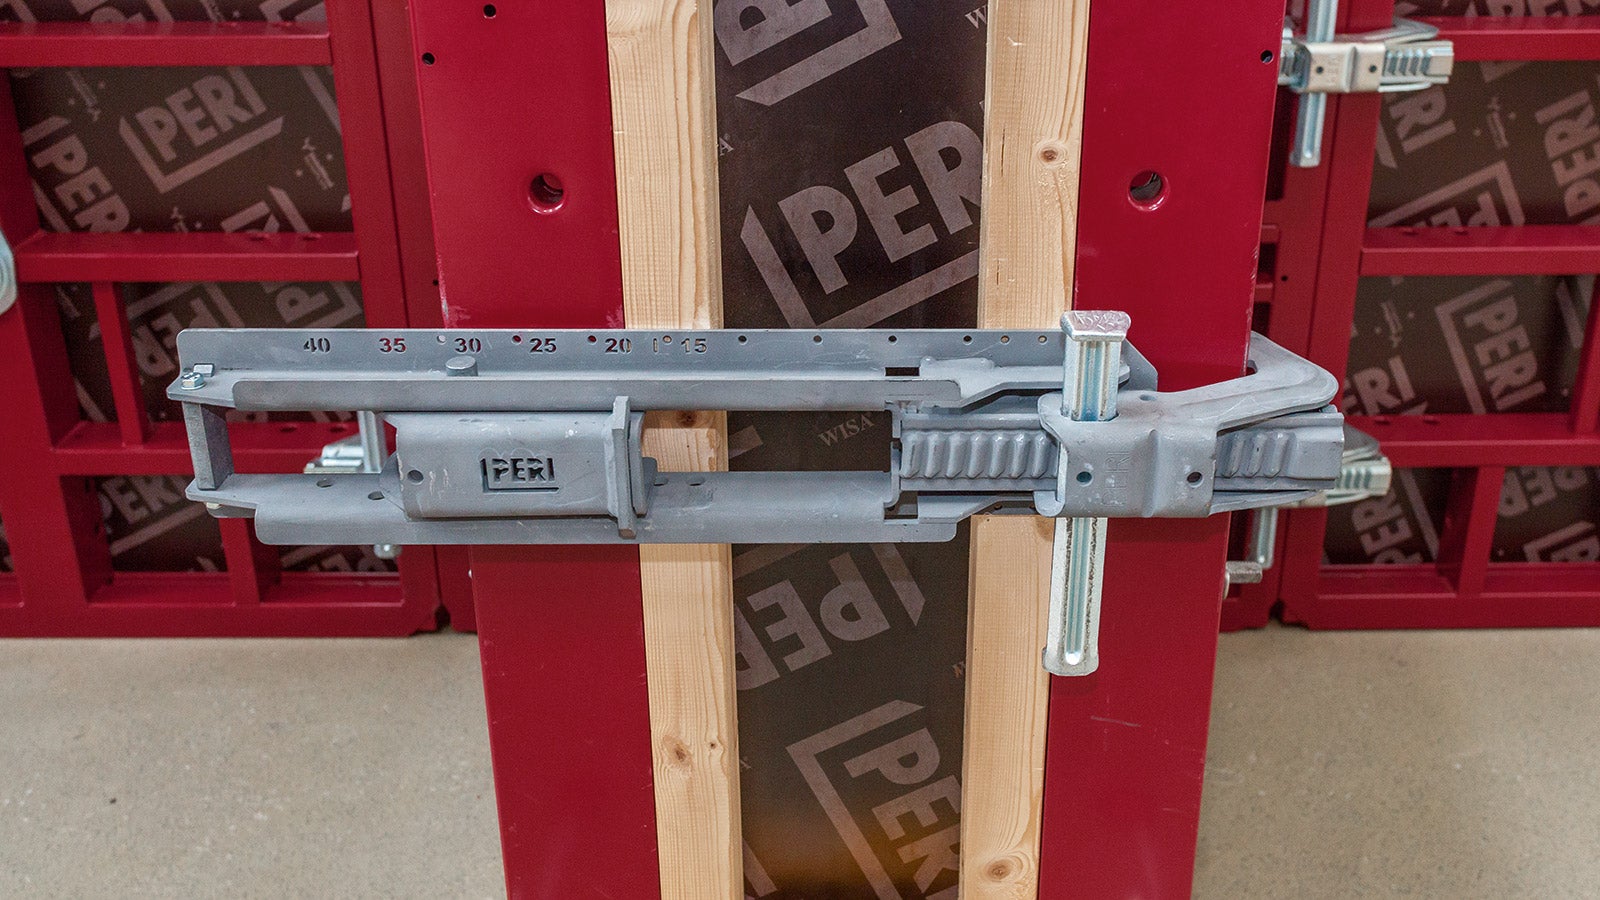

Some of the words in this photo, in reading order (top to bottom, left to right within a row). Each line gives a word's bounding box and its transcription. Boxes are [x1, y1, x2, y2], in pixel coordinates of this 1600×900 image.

[135, 66, 267, 162] PERI
[1386, 87, 1456, 155] RI
[32, 134, 131, 232] PER
[778, 121, 983, 295] PER
[303, 337, 331, 353] 40
[379, 337, 407, 353] 35
[454, 337, 482, 353] 30
[529, 337, 557, 353] 25
[605, 337, 632, 353] 20
[681, 337, 708, 353] 15
[1343, 355, 1415, 416] RI
[1464, 296, 1546, 411] PERI
[490, 457, 555, 482] PERI
[818, 414, 875, 447] WISA
[1498, 466, 1588, 517] PER
[734, 552, 891, 691] PER
[843, 727, 963, 900] PER
